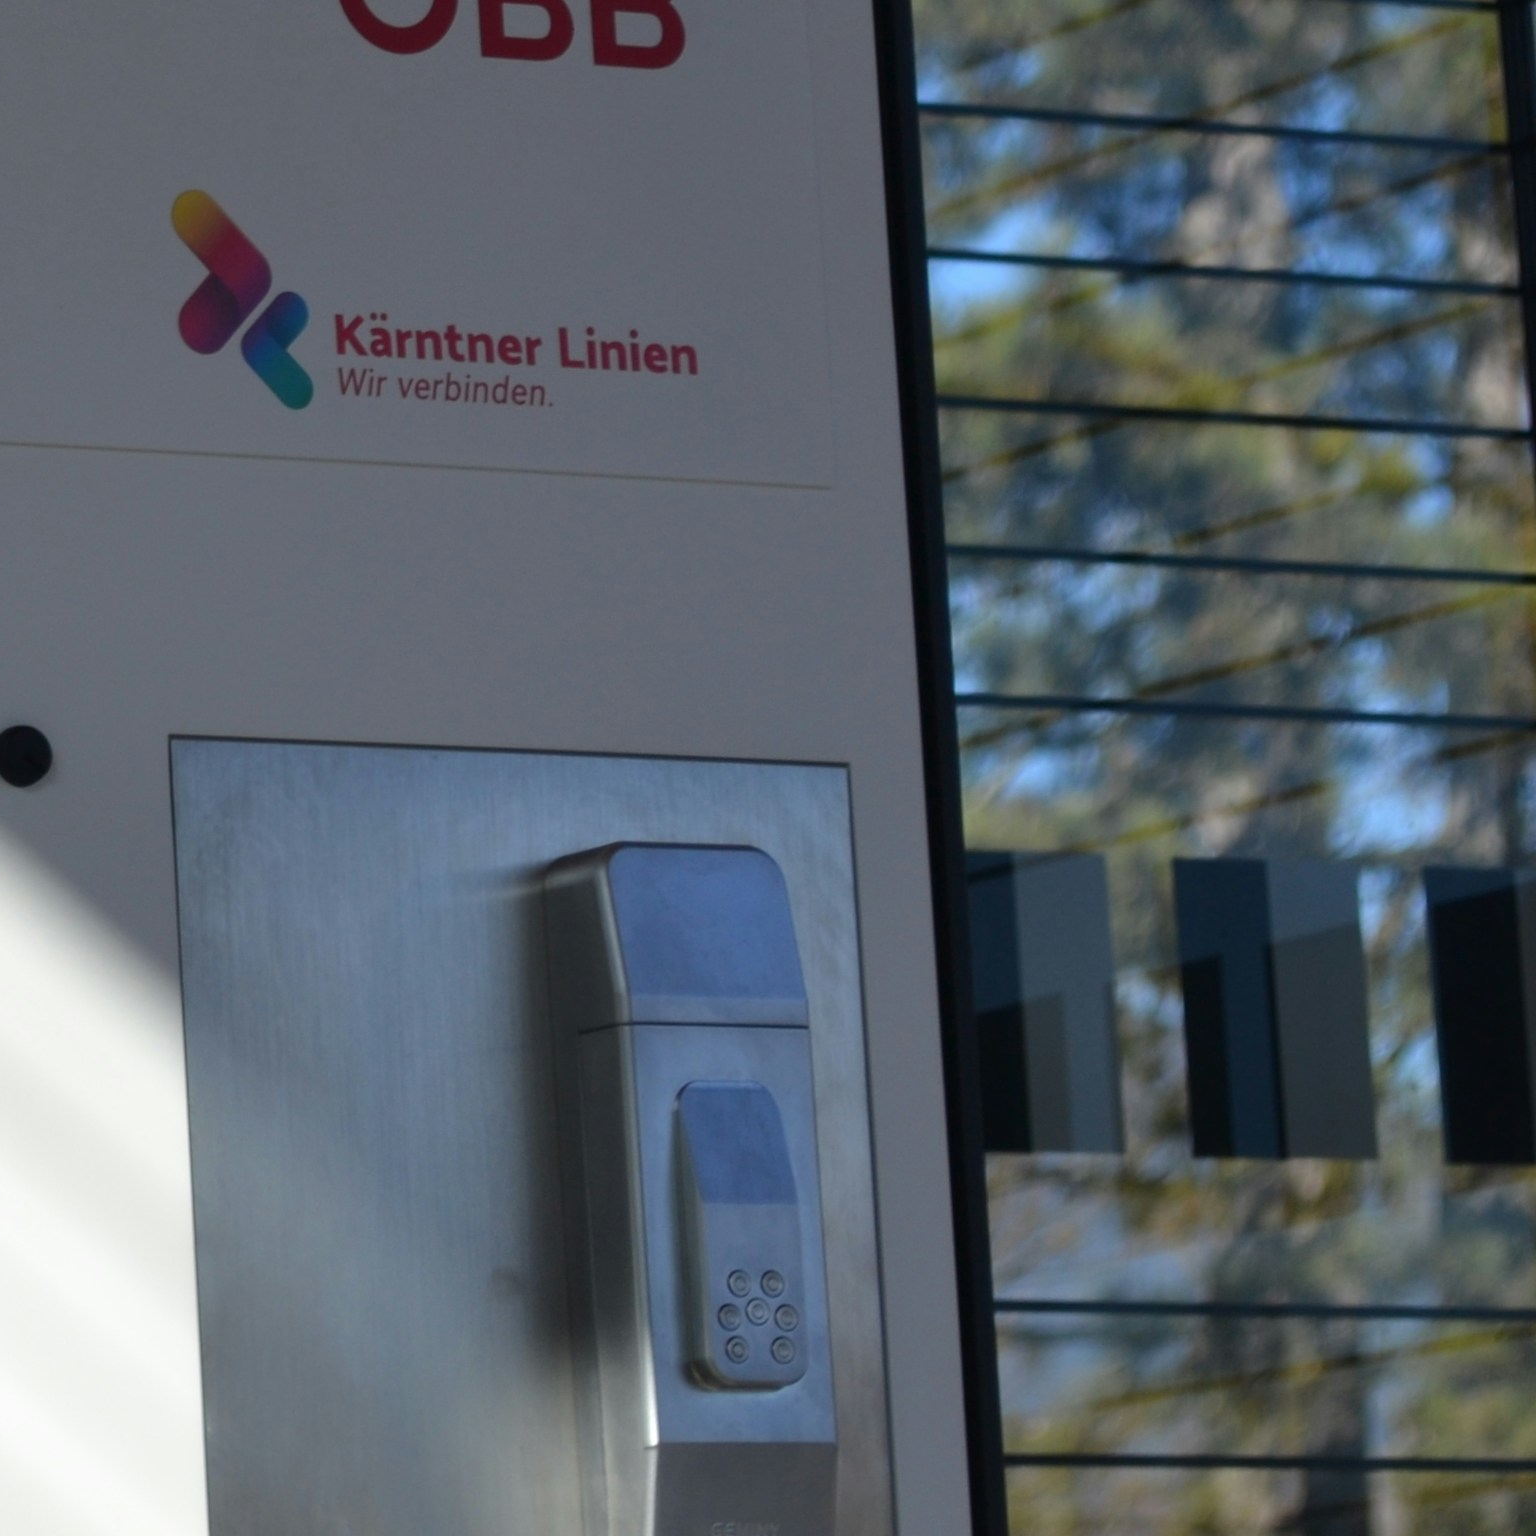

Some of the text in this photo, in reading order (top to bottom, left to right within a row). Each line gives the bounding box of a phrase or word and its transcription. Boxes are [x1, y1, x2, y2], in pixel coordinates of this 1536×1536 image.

[334, 311, 699, 375] Kärntner Linien
[337, 367, 555, 408] Wir verbinden.
